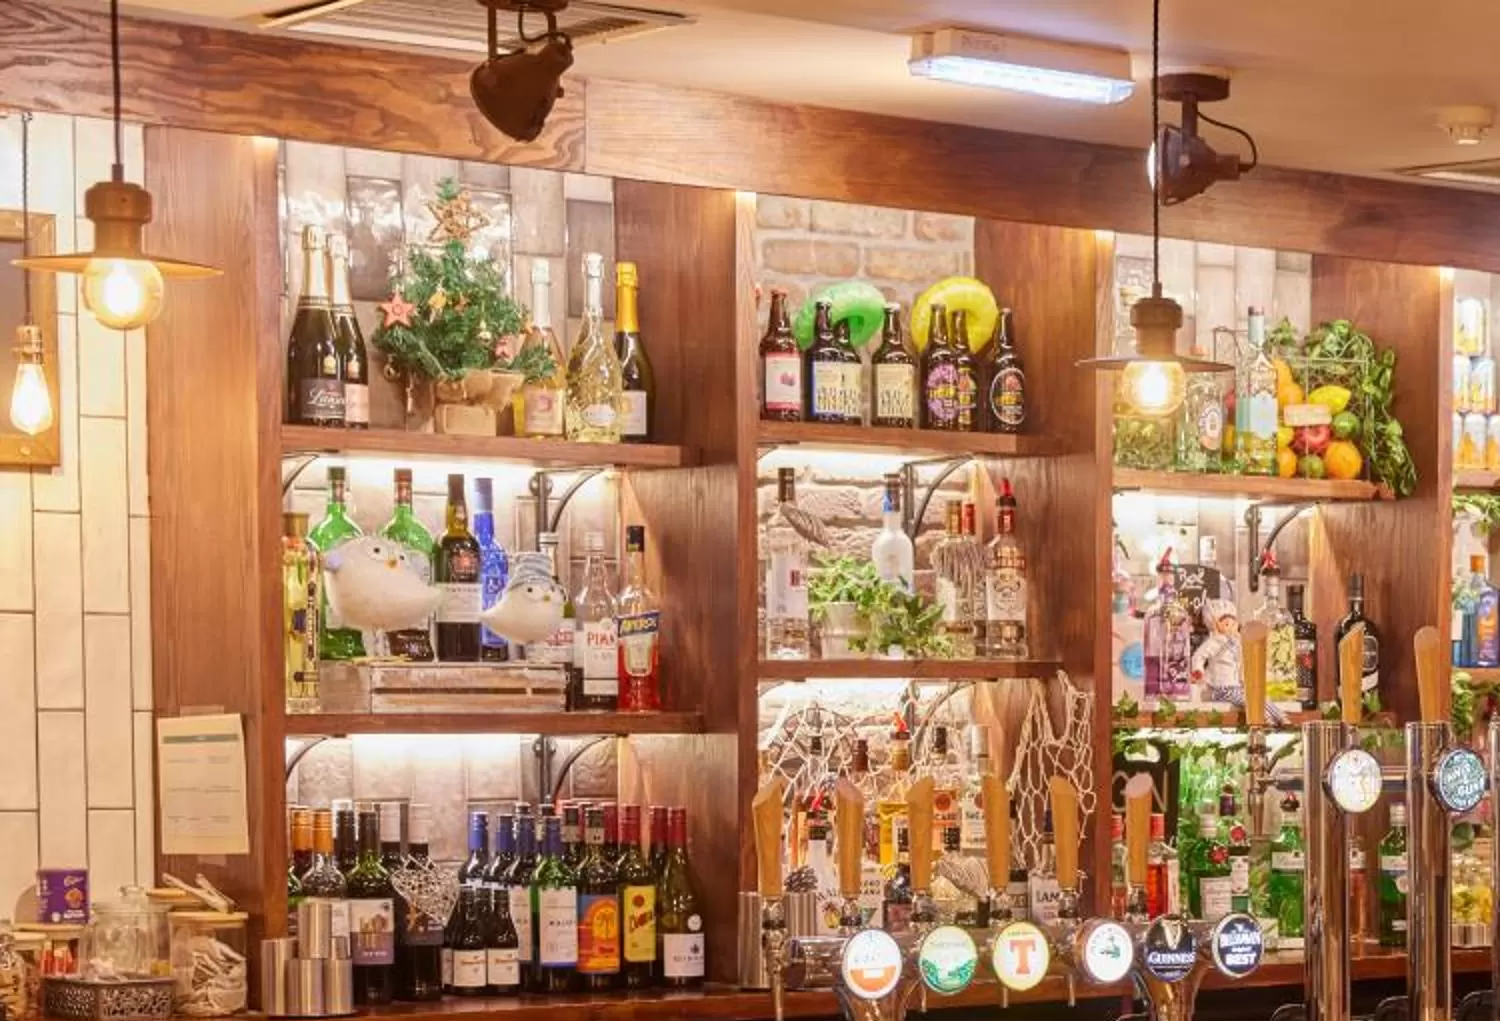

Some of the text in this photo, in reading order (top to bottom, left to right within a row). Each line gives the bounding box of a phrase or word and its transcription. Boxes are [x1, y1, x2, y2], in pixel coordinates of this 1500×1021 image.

[1009, 939, 1036, 975] T
[1147, 951, 1196, 965] GUINNESS
[1225, 953, 1257, 967] BEST
